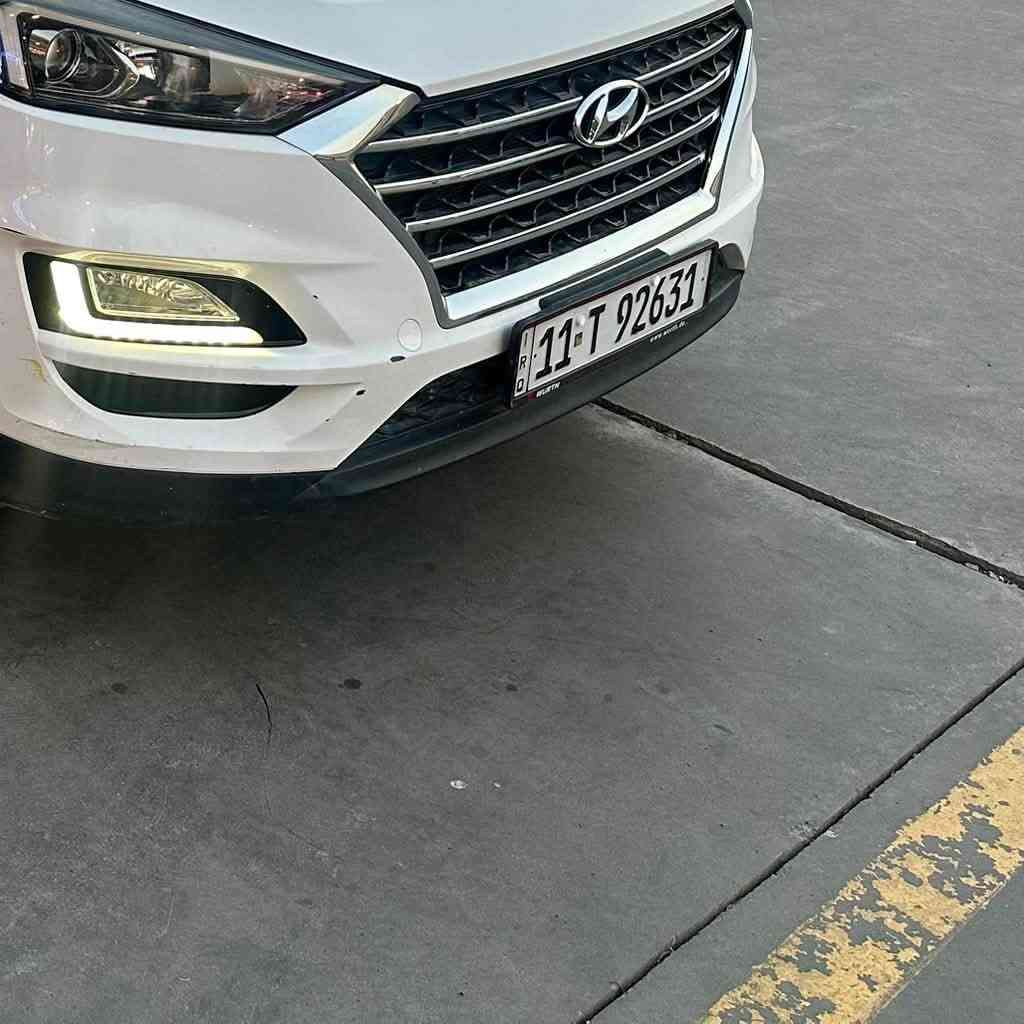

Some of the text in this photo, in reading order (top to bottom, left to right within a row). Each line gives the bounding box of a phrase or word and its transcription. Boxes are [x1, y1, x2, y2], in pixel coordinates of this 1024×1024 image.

[535, 262, 698, 380] 11 T 92631
